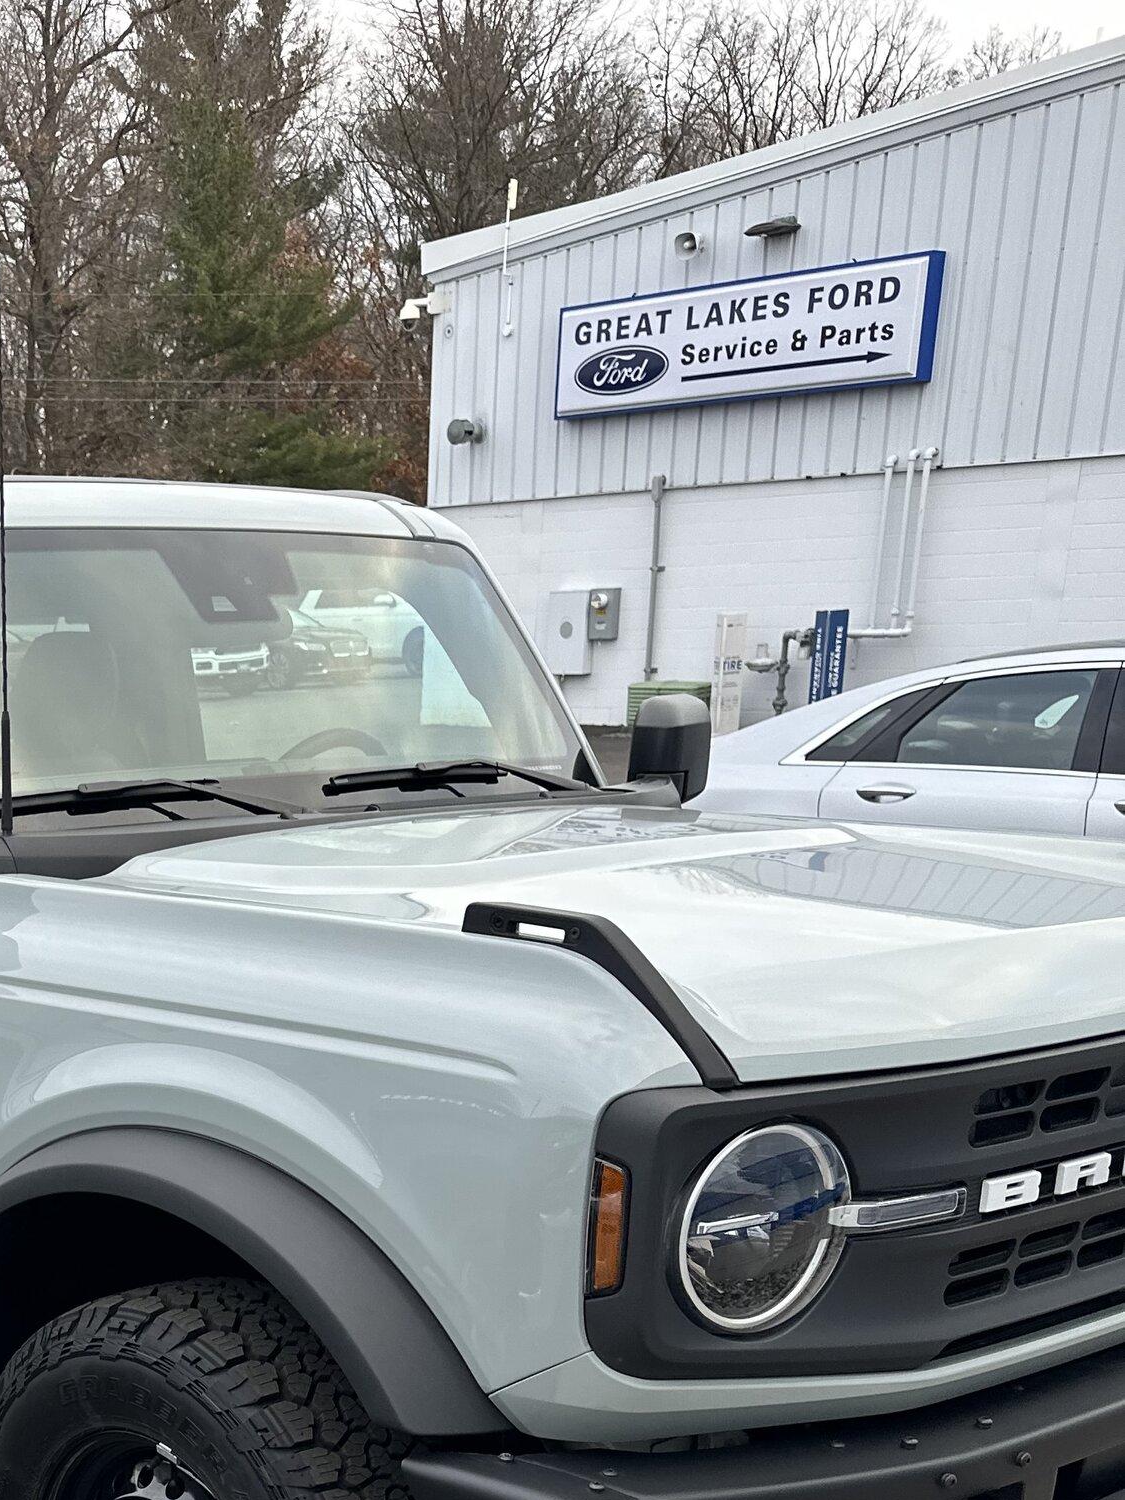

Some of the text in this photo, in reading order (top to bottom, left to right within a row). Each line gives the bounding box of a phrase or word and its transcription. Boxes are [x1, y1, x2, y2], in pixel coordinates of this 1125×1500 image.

[575, 276, 901, 345] GREAT LAKES FORD
[593, 353, 649, 387] Ford
[681, 321, 895, 366] Service & Parts
[978, 1151, 1125, 1213] BR
[58, 1373, 230, 1475] GRABBER
